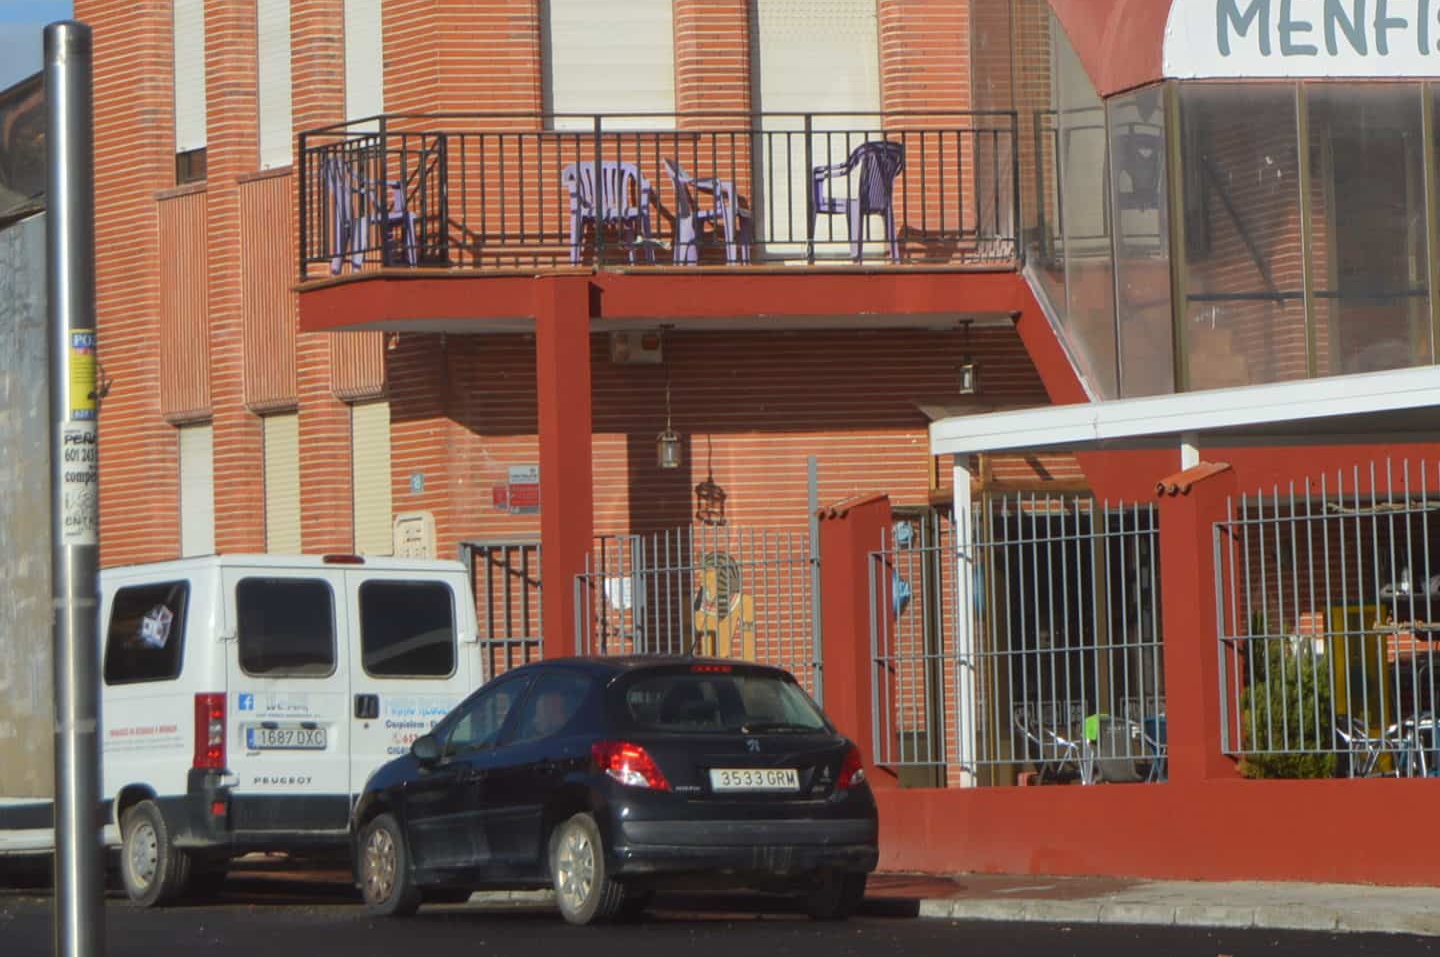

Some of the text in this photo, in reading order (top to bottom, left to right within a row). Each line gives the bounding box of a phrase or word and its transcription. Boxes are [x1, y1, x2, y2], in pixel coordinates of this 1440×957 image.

[261, 730, 323, 745] 1687 DXC
[253, 776, 312, 785] PEUGEOT
[721, 770, 795, 786] 3533 GRM
